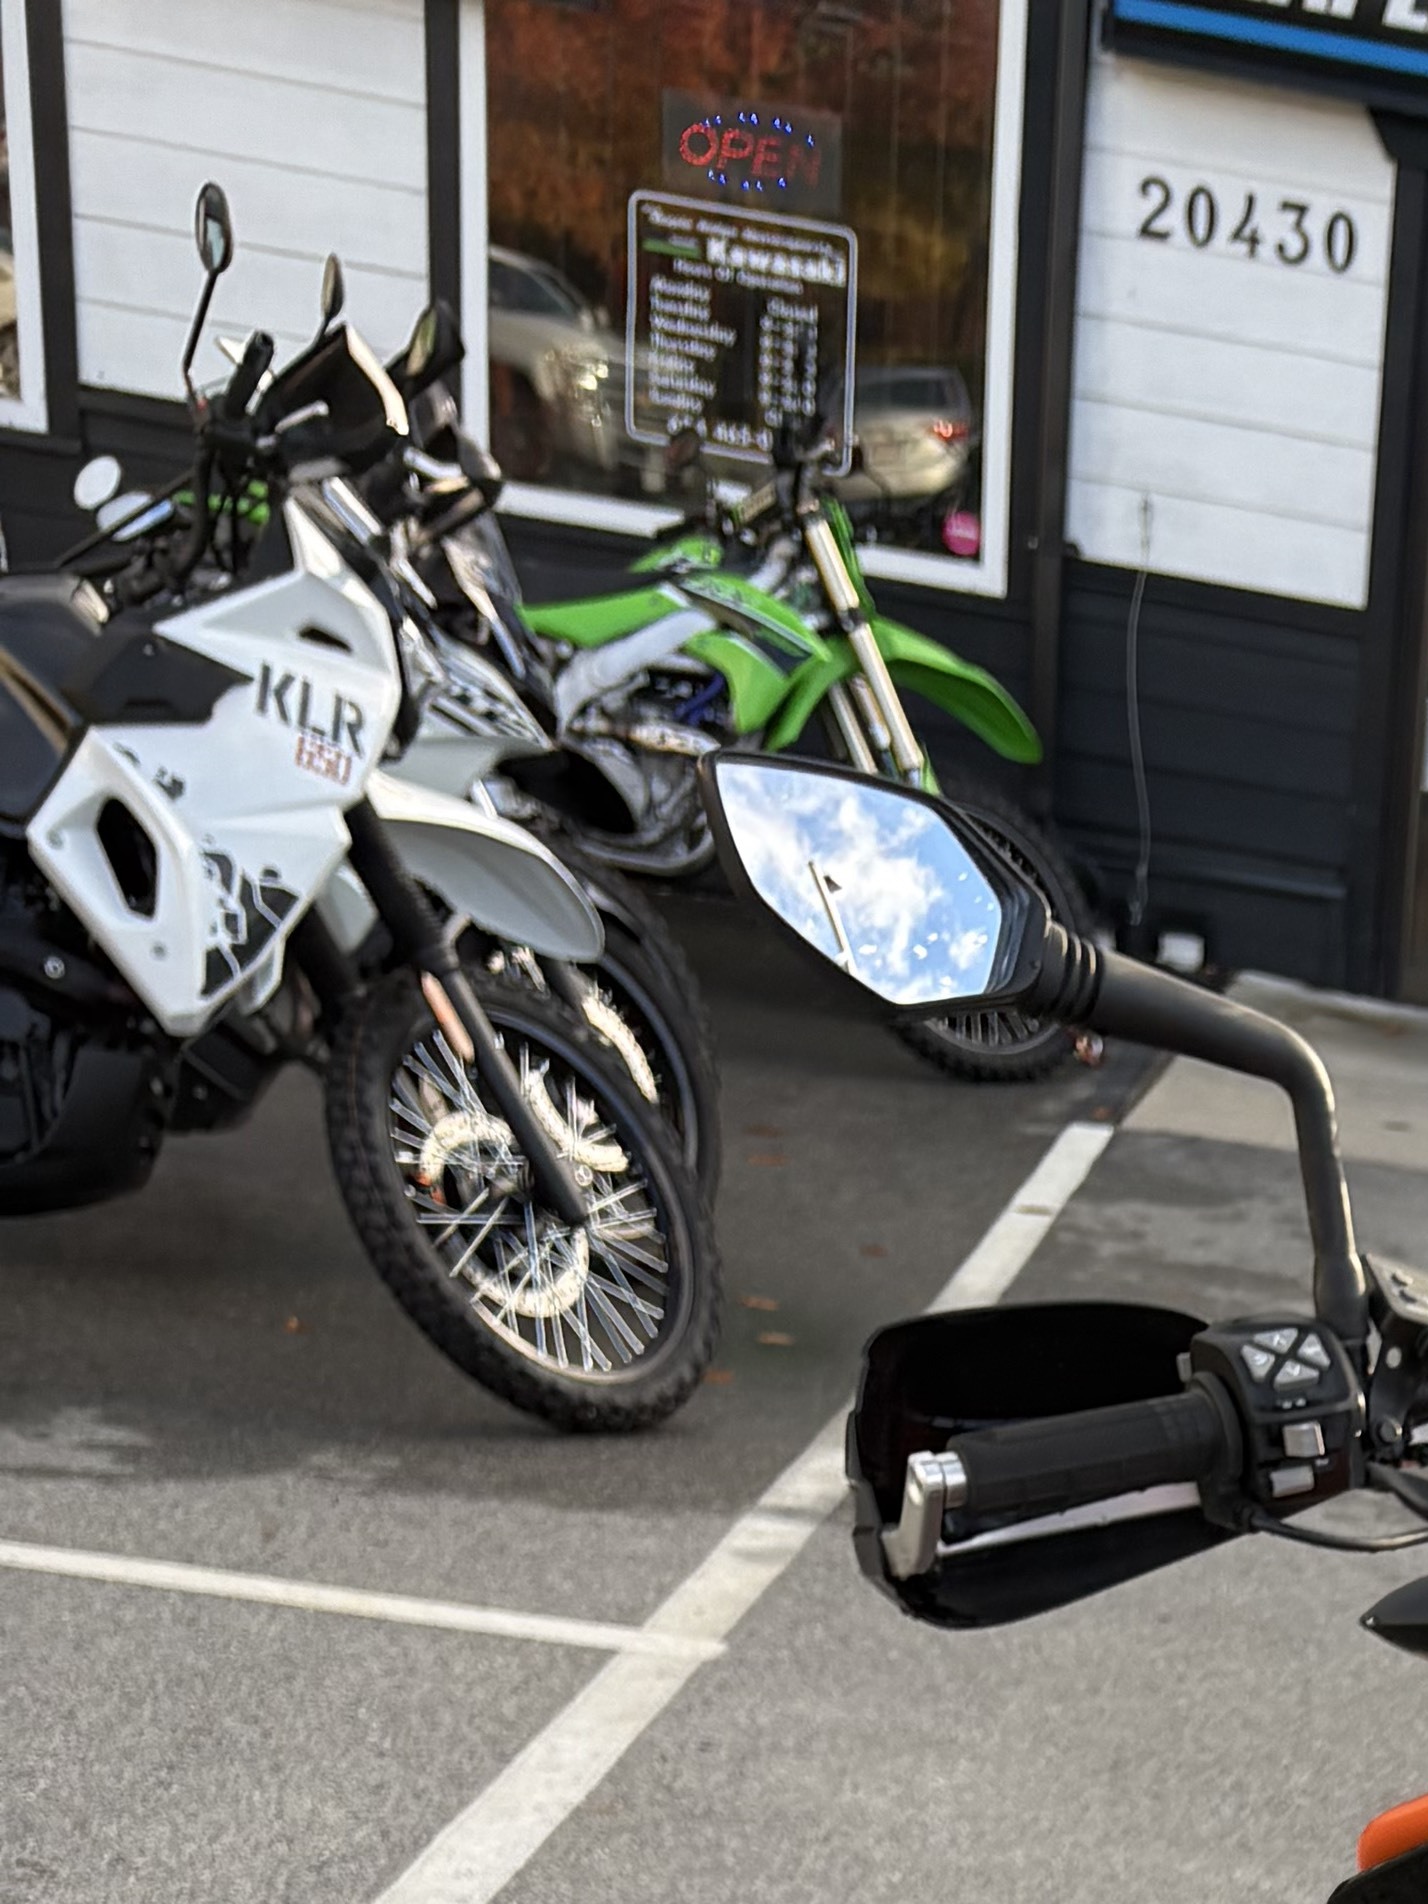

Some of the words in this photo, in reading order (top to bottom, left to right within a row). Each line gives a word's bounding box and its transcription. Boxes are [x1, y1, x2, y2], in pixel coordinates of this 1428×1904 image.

[679, 122, 822, 189] OPEN
[1138, 176, 1356, 275] 20430
[255, 659, 365, 759] KLR
